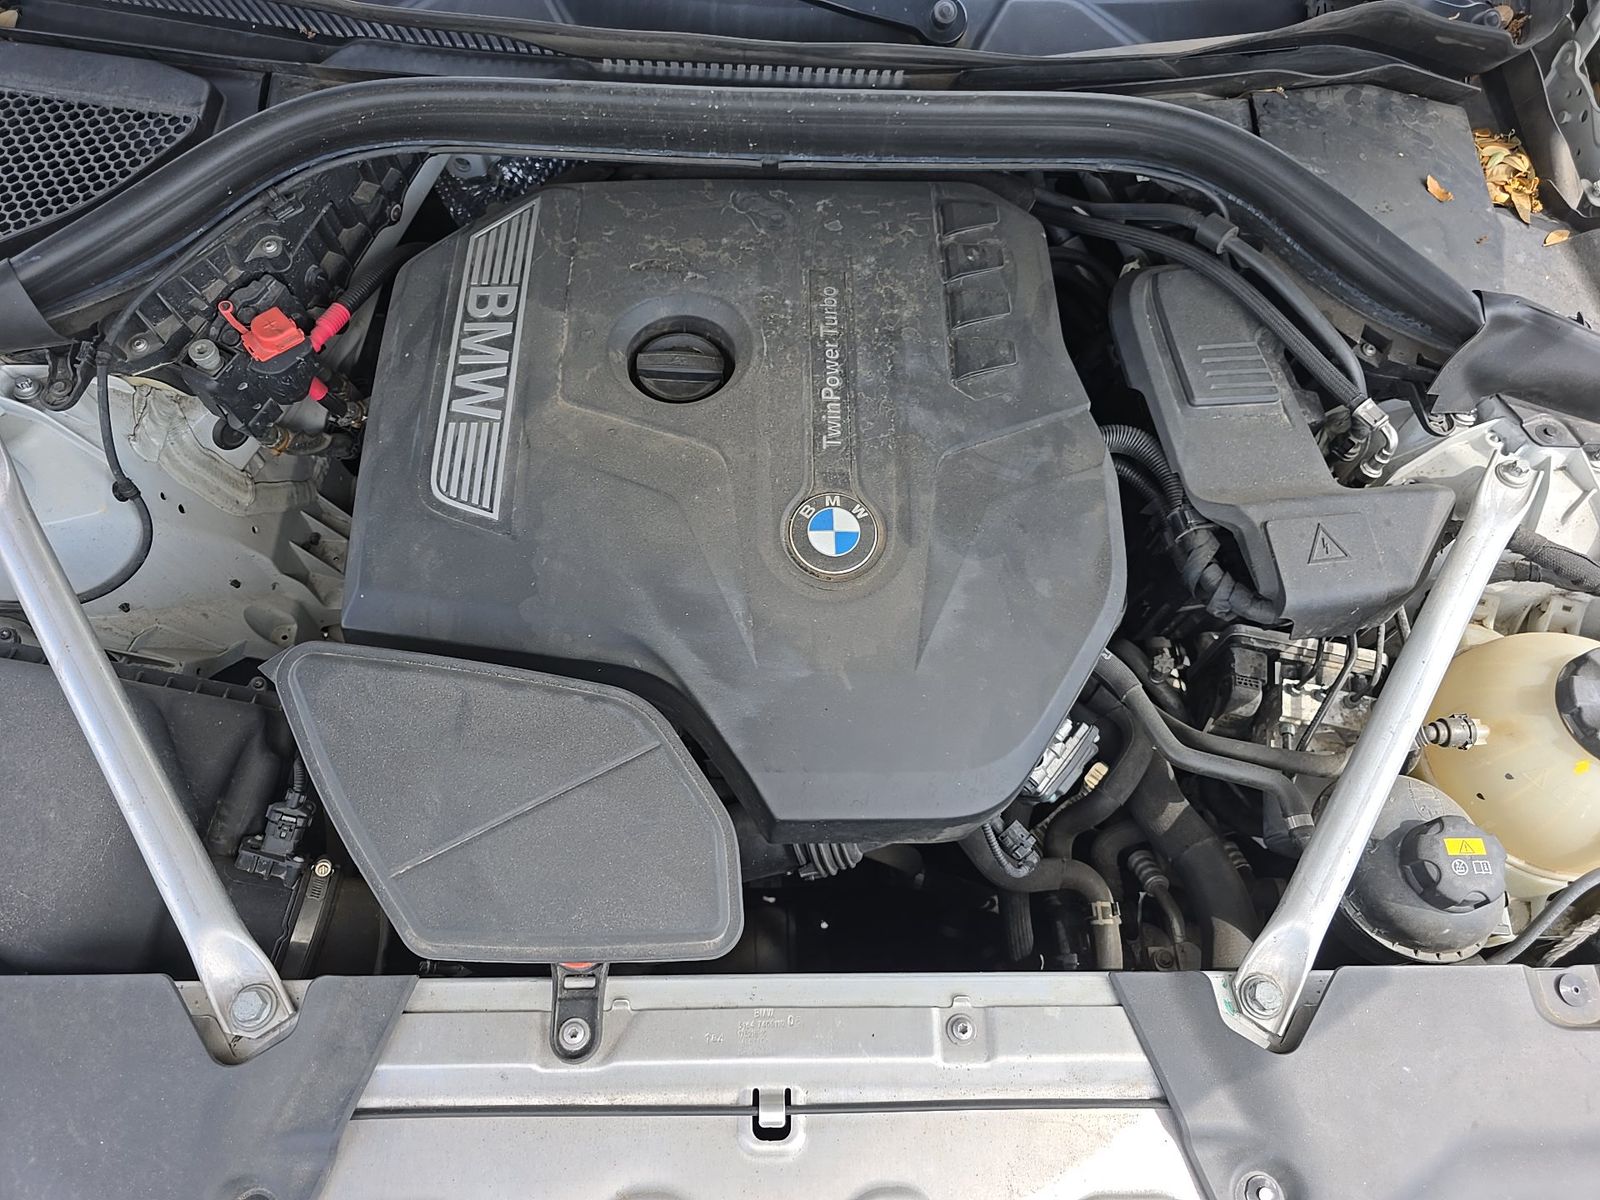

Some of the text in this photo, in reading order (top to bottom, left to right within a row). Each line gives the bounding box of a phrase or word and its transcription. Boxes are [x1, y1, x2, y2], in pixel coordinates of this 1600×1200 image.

[449, 285, 519, 420] BMW
[820, 286, 842, 450] TwinPower Turbo
[799, 495, 869, 520] BMW
